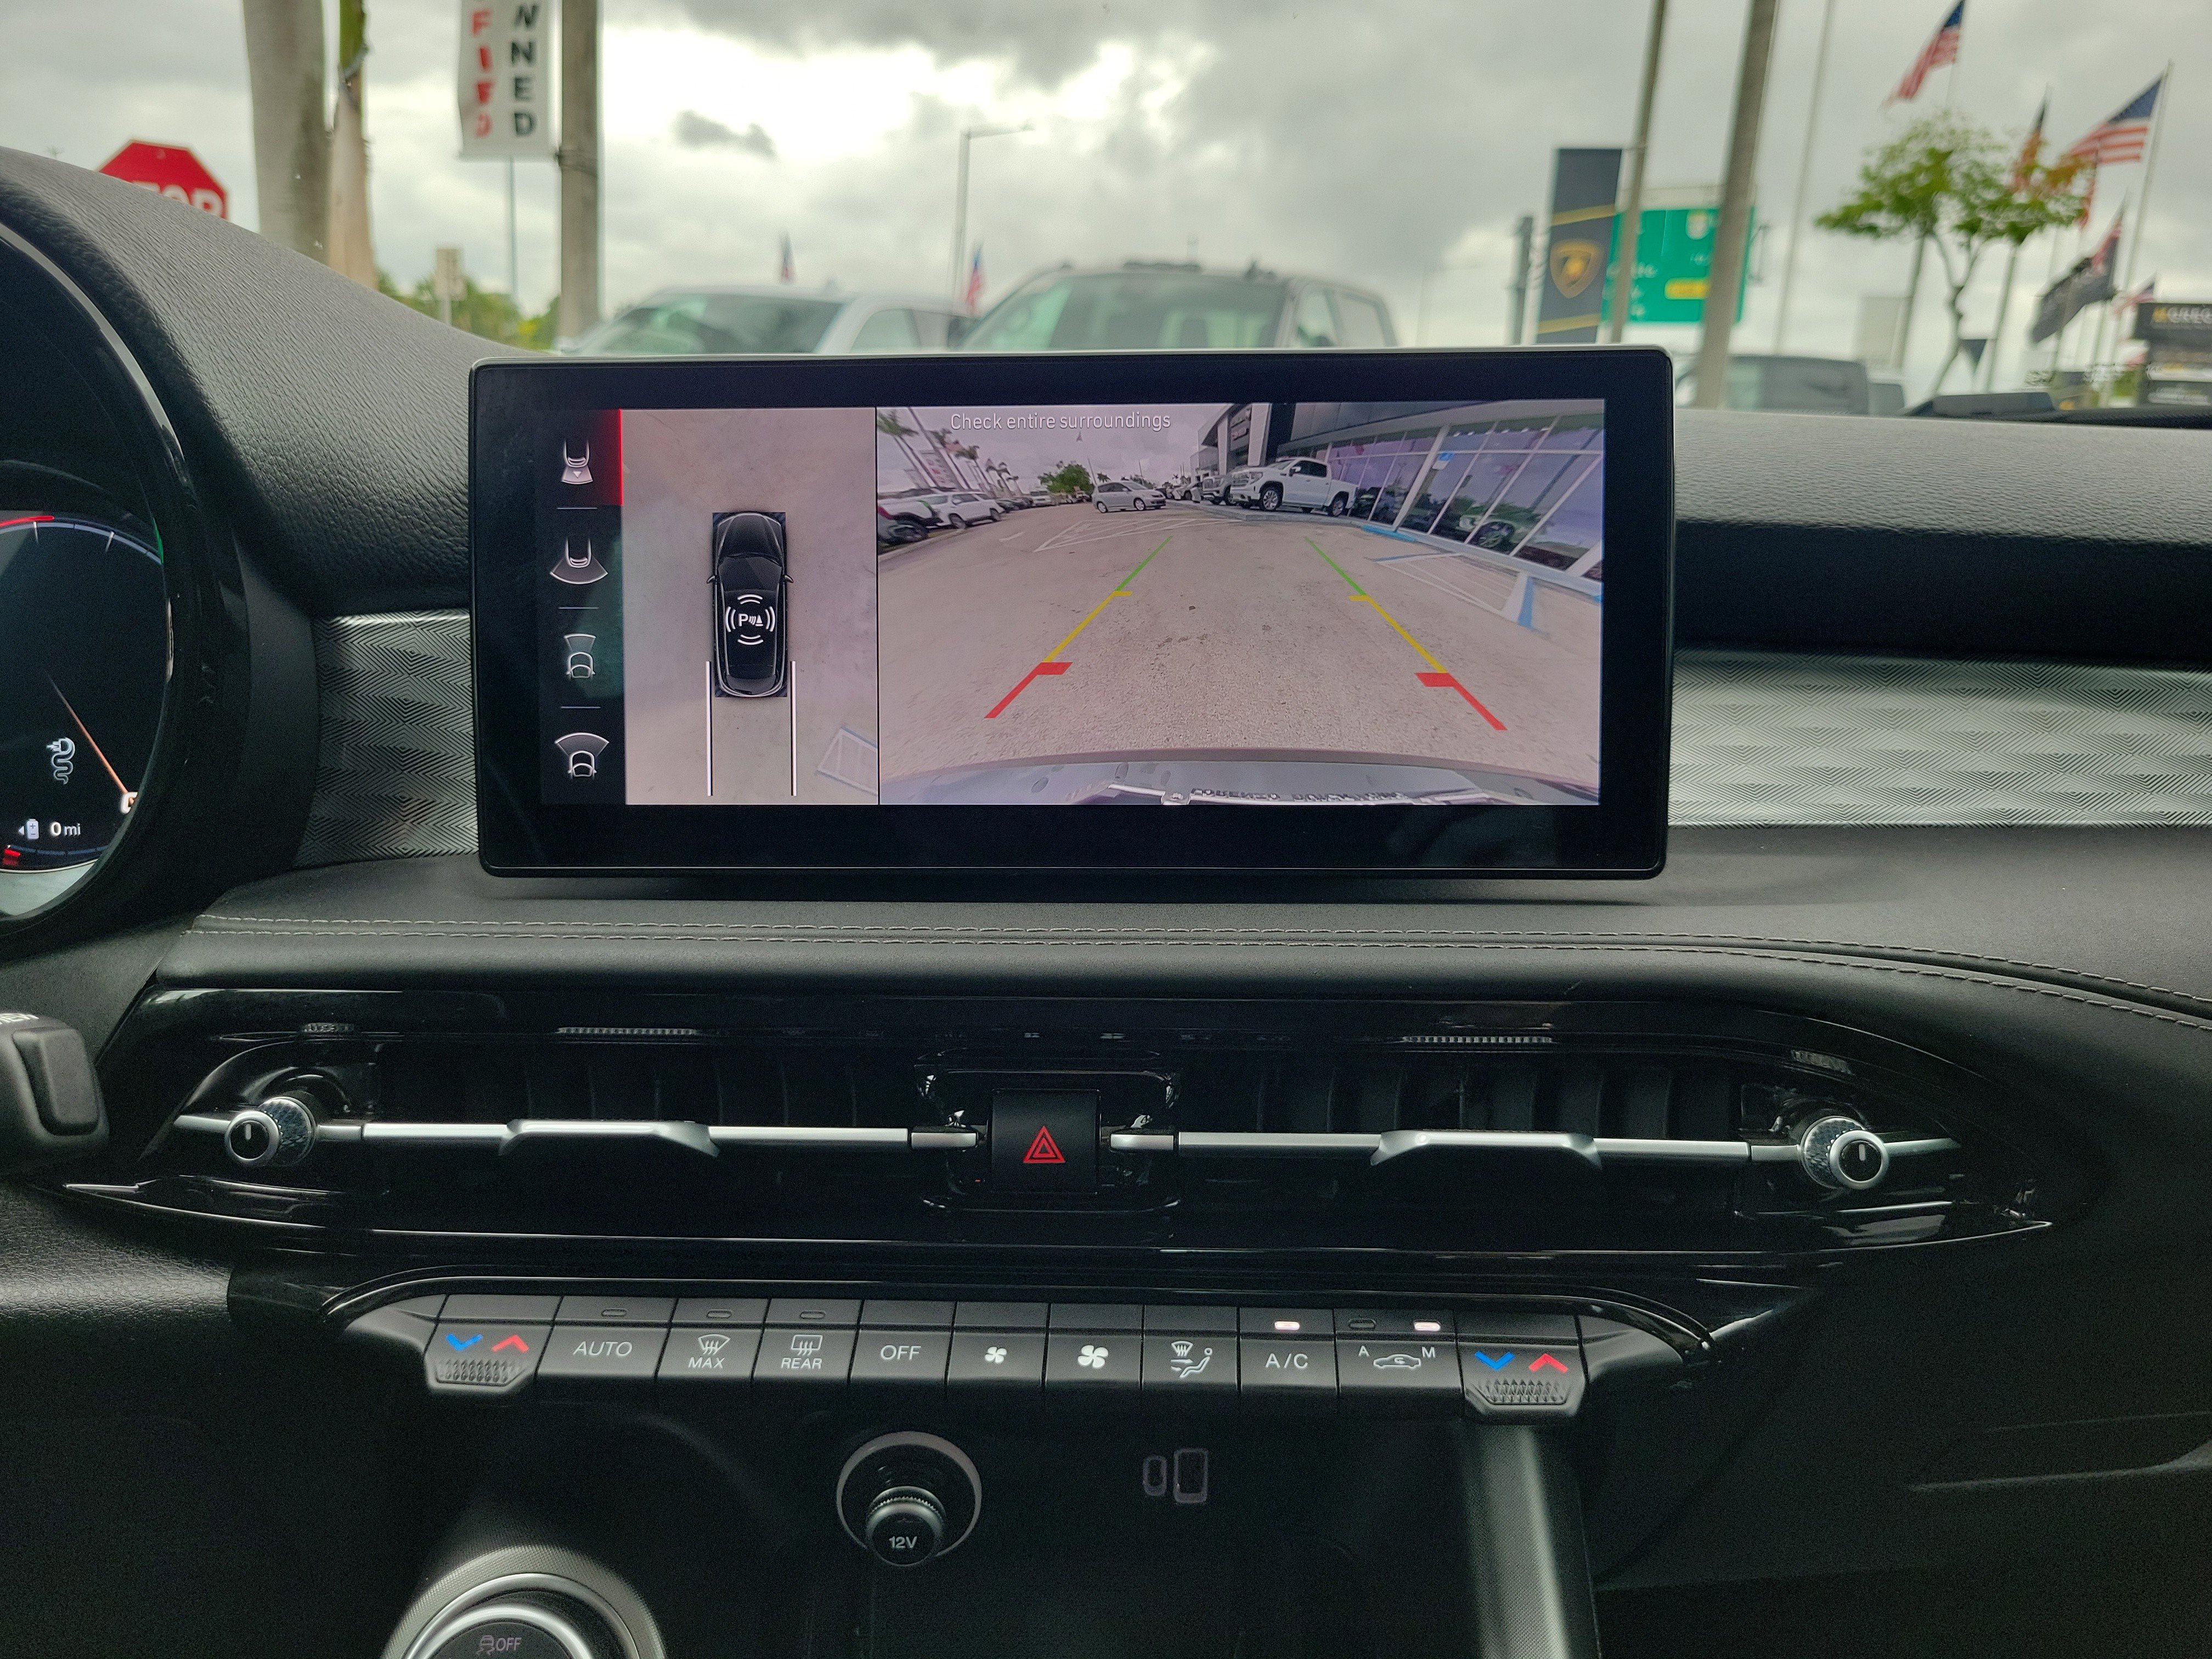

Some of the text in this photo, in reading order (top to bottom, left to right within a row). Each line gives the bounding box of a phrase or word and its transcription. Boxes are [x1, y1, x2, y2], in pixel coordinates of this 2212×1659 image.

[951, 411, 1171, 432] Check entire surroundings
[50, 822, 81, 836] 0 mi
[573, 1341, 633, 1357] AUTO
[880, 1345, 922, 1361] OFF
[1358, 1345, 1370, 1357] A
[1421, 1346, 1436, 1358] M
[688, 1357, 725, 1369] MAX
[781, 1358, 822, 1369] REAR
[1265, 1353, 1308, 1369] A/C
[889, 1536, 917, 1549] 12V
[496, 1637, 522, 1651] OFF
